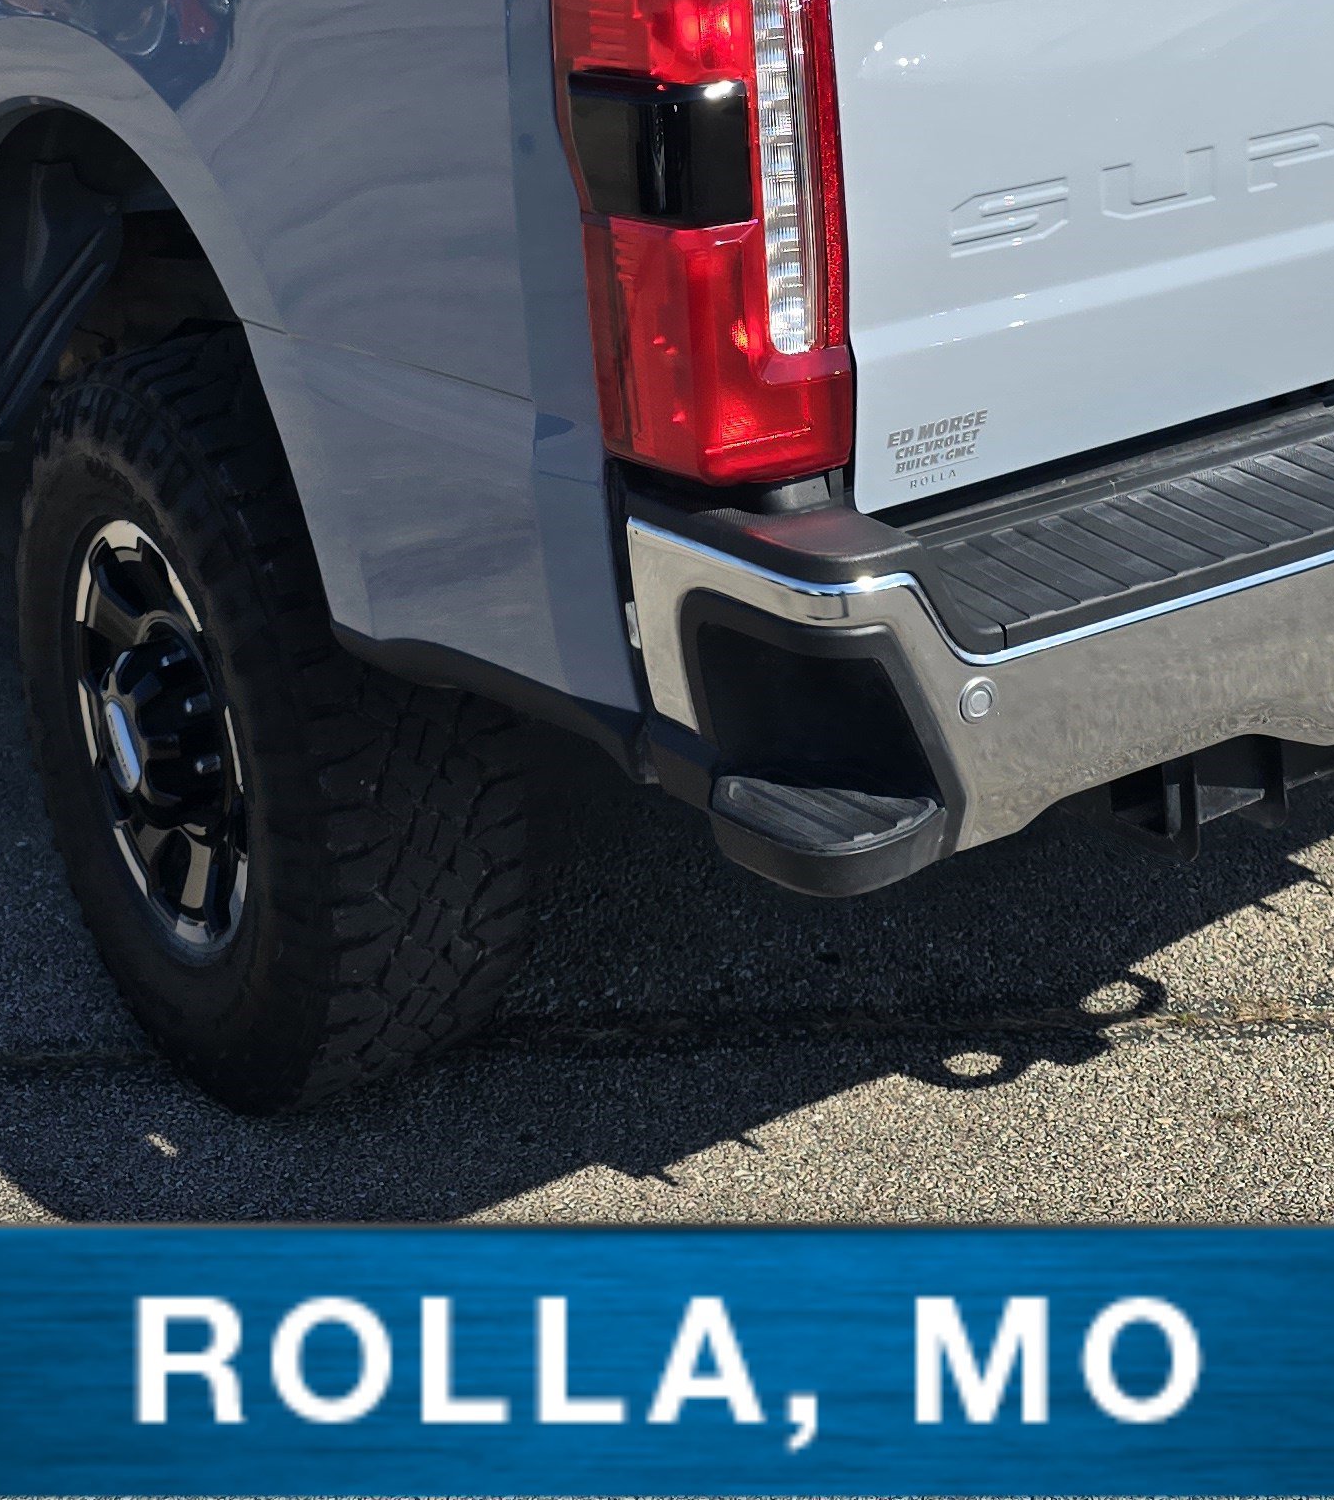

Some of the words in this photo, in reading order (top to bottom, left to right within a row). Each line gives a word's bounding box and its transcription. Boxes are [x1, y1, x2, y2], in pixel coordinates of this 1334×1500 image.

[886, 427, 915, 450] ED
[917, 408, 989, 442] MORSE
[894, 428, 981, 460] CHEVROLET
[909, 468, 958, 490] ROLLA
